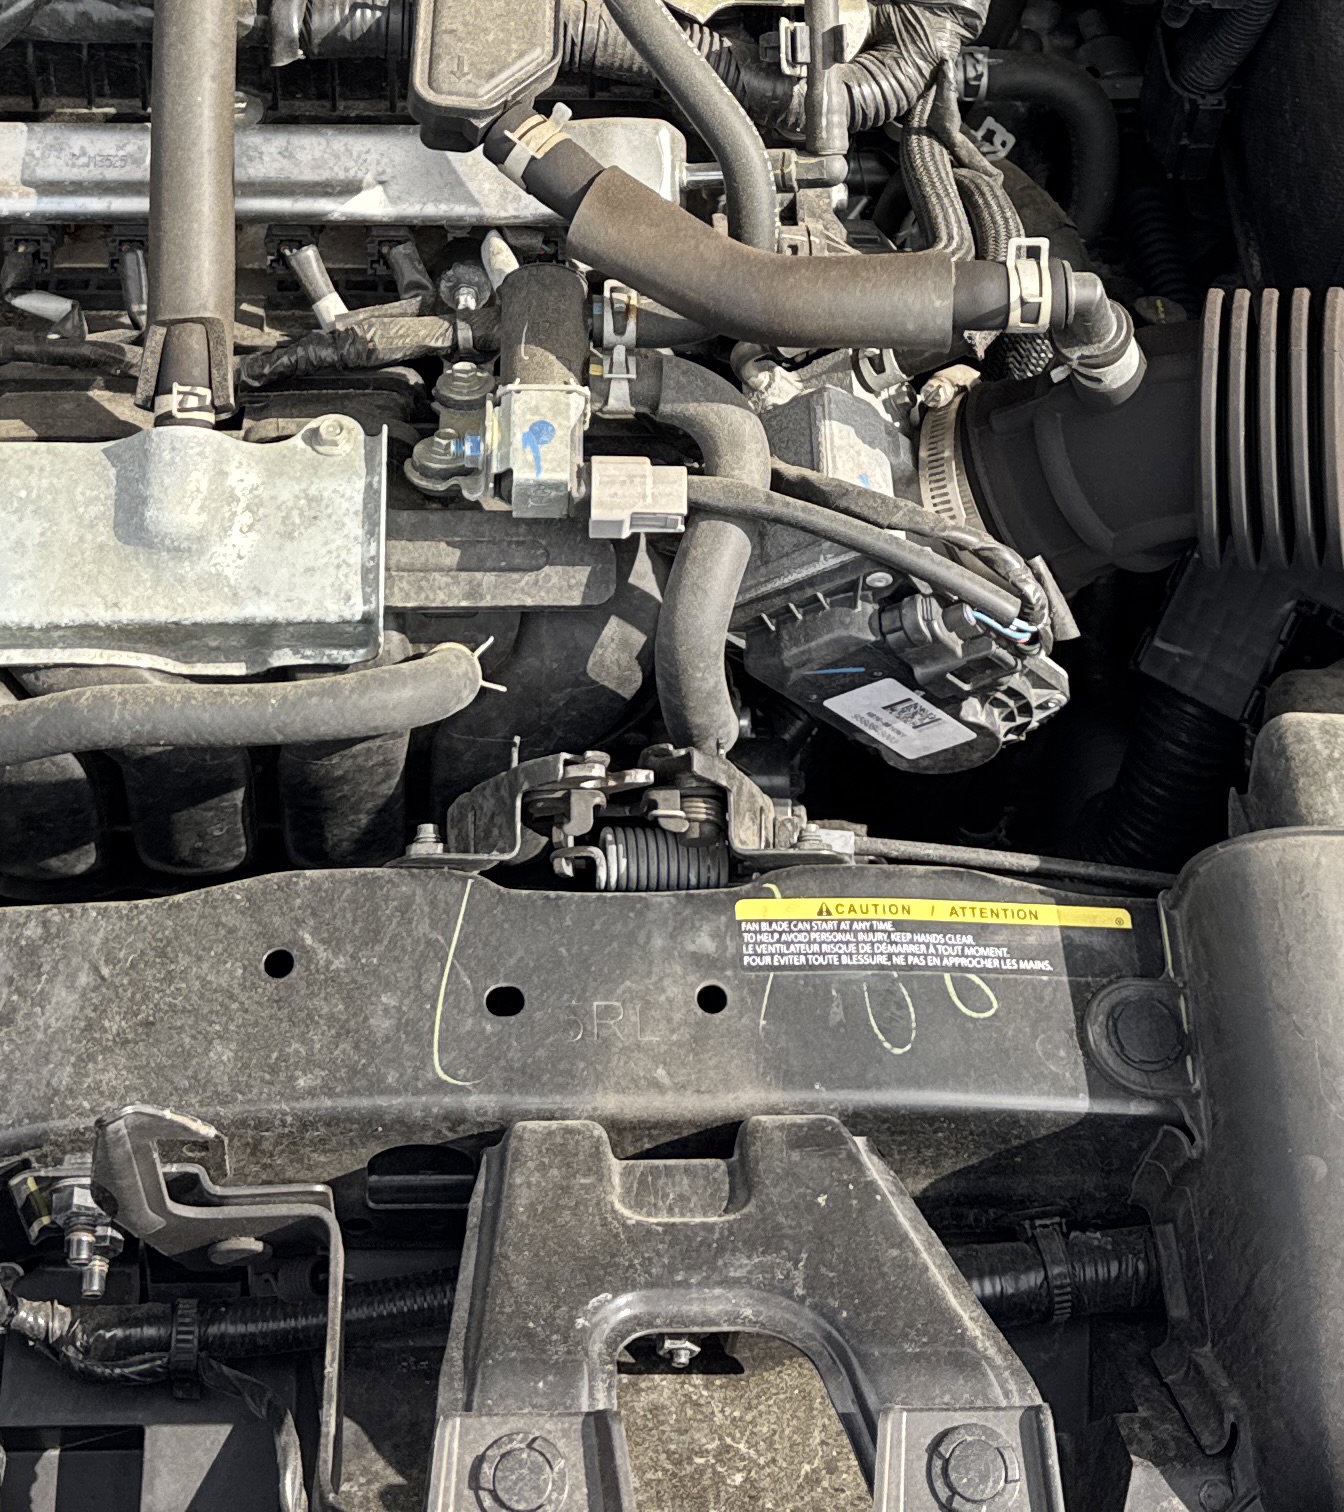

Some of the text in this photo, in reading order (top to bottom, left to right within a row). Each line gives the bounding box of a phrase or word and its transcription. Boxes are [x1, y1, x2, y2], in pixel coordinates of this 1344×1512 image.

[835, 903, 911, 916] CAUTION
[949, 906, 1039, 920] ATTENTION
[741, 921, 895, 932] FAN BLADE CAN START AT ANY TIME.
[743, 933, 975, 945] TO HELP AVOID PERSONAL INJURY, KEEP HANDS CLEAR.
[743, 942, 1010, 957] LE VENTILATEUR RISQUE DE DÉMARRER À TOUT MOMENT.
[743, 954, 1053, 971] POUR ÉVITER TOUTE BLESSURE, NE PAS EN APPROCHER LES MAINS.
